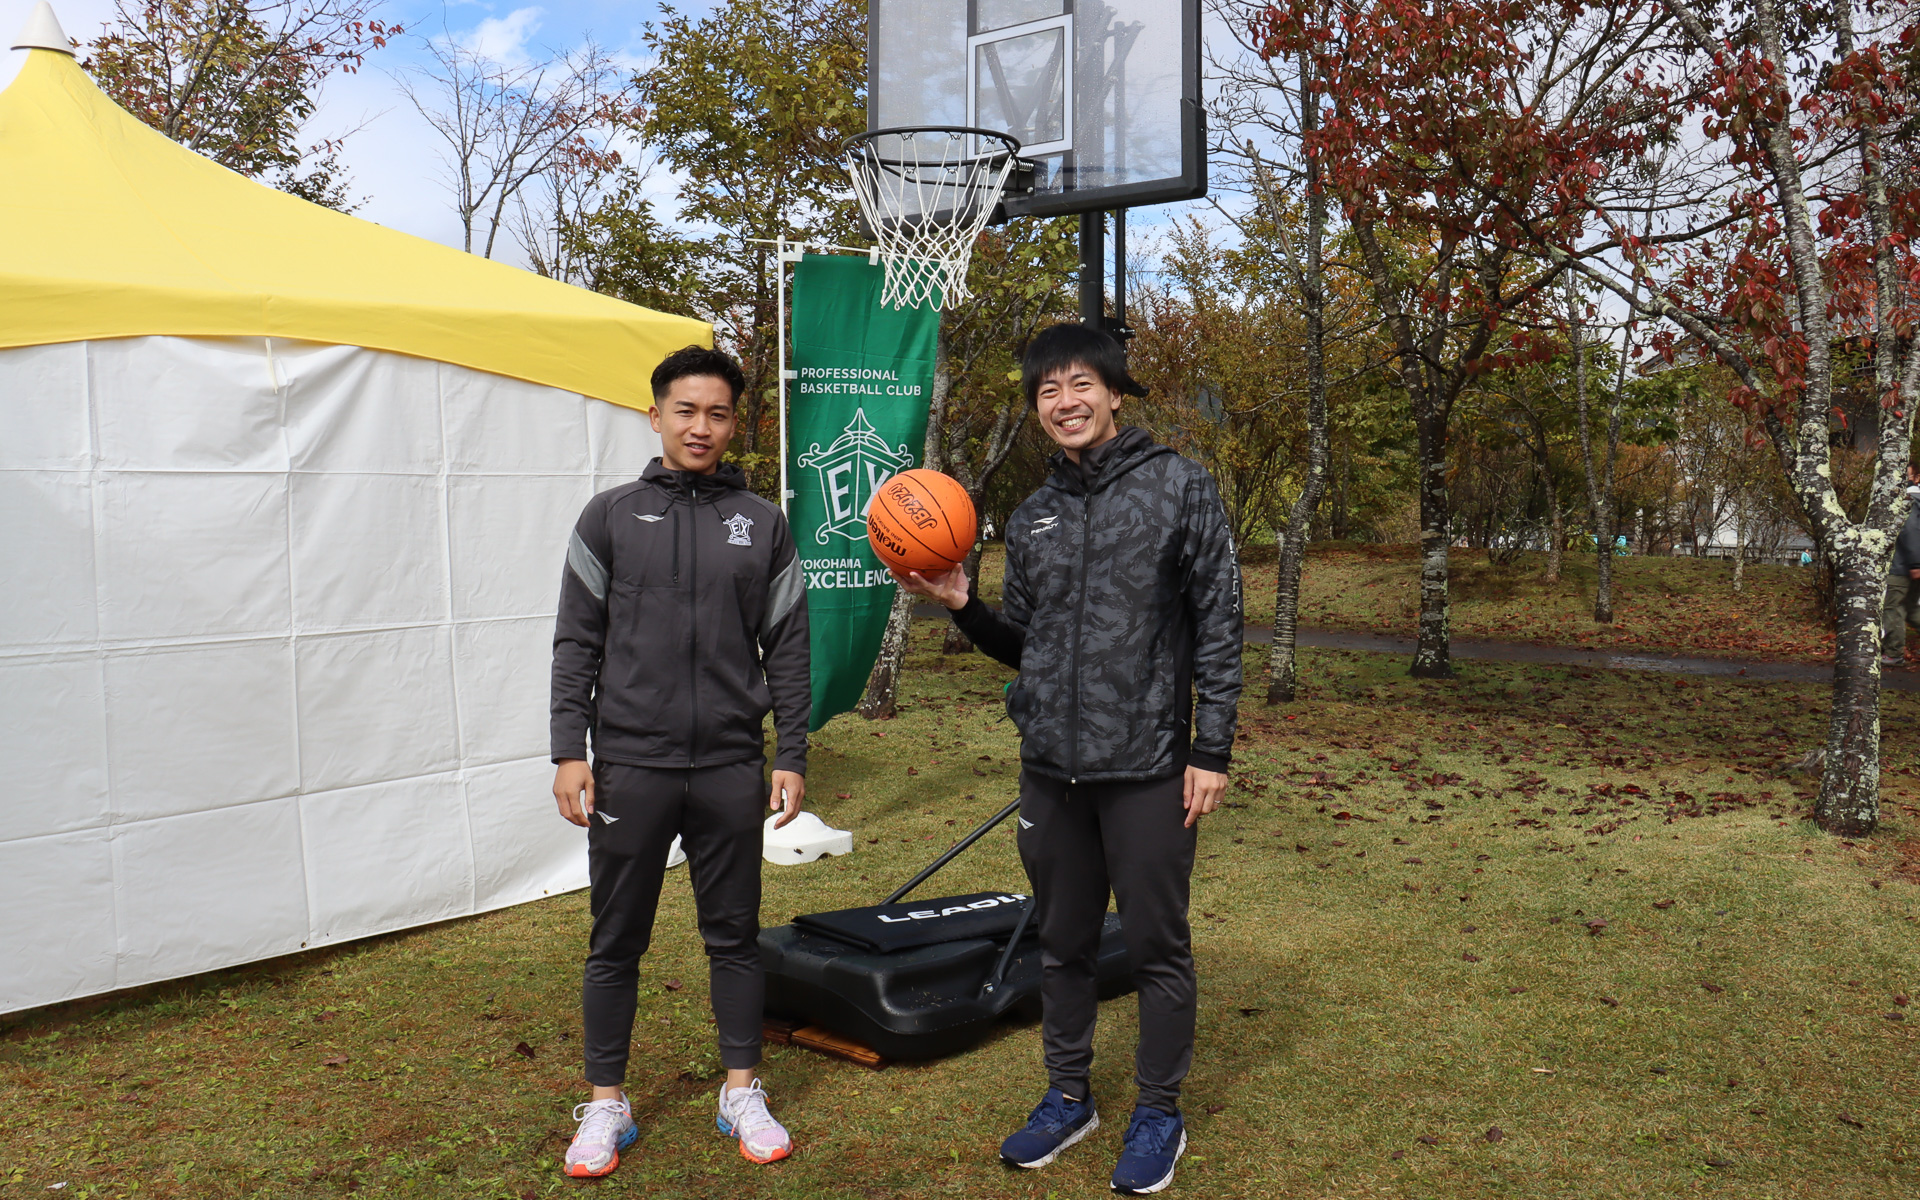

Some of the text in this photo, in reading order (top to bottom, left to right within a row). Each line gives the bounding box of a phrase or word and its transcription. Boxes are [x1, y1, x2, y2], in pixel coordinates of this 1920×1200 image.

[801, 367, 899, 381] PROFESSIONAL
[800, 383, 922, 396] BASKETBALL CLUB
[887, 482, 938, 530] JB2020
[868, 514, 907, 557] molten
[1031, 522, 1059, 535] PENALTY
[803, 567, 897, 590] XCELLENC
